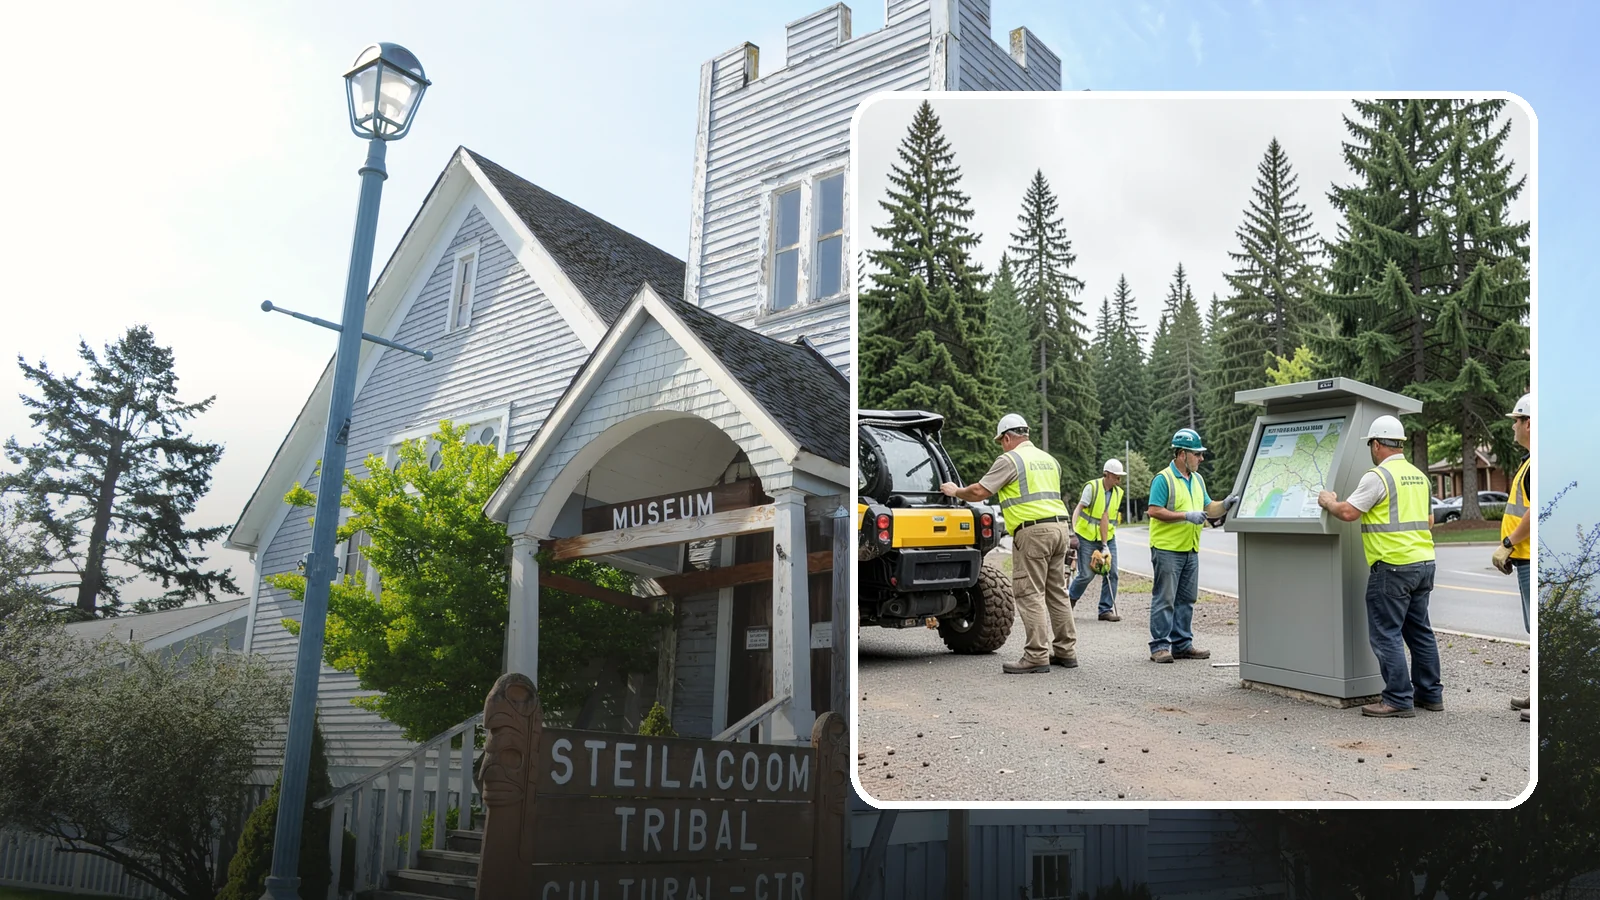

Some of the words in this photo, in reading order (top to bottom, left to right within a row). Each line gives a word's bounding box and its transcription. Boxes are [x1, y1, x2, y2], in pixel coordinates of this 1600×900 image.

[612, 491, 714, 531] MUSEUM
[550, 738, 810, 792] STEILACOOM
[615, 806, 758, 852] TRIBAL
